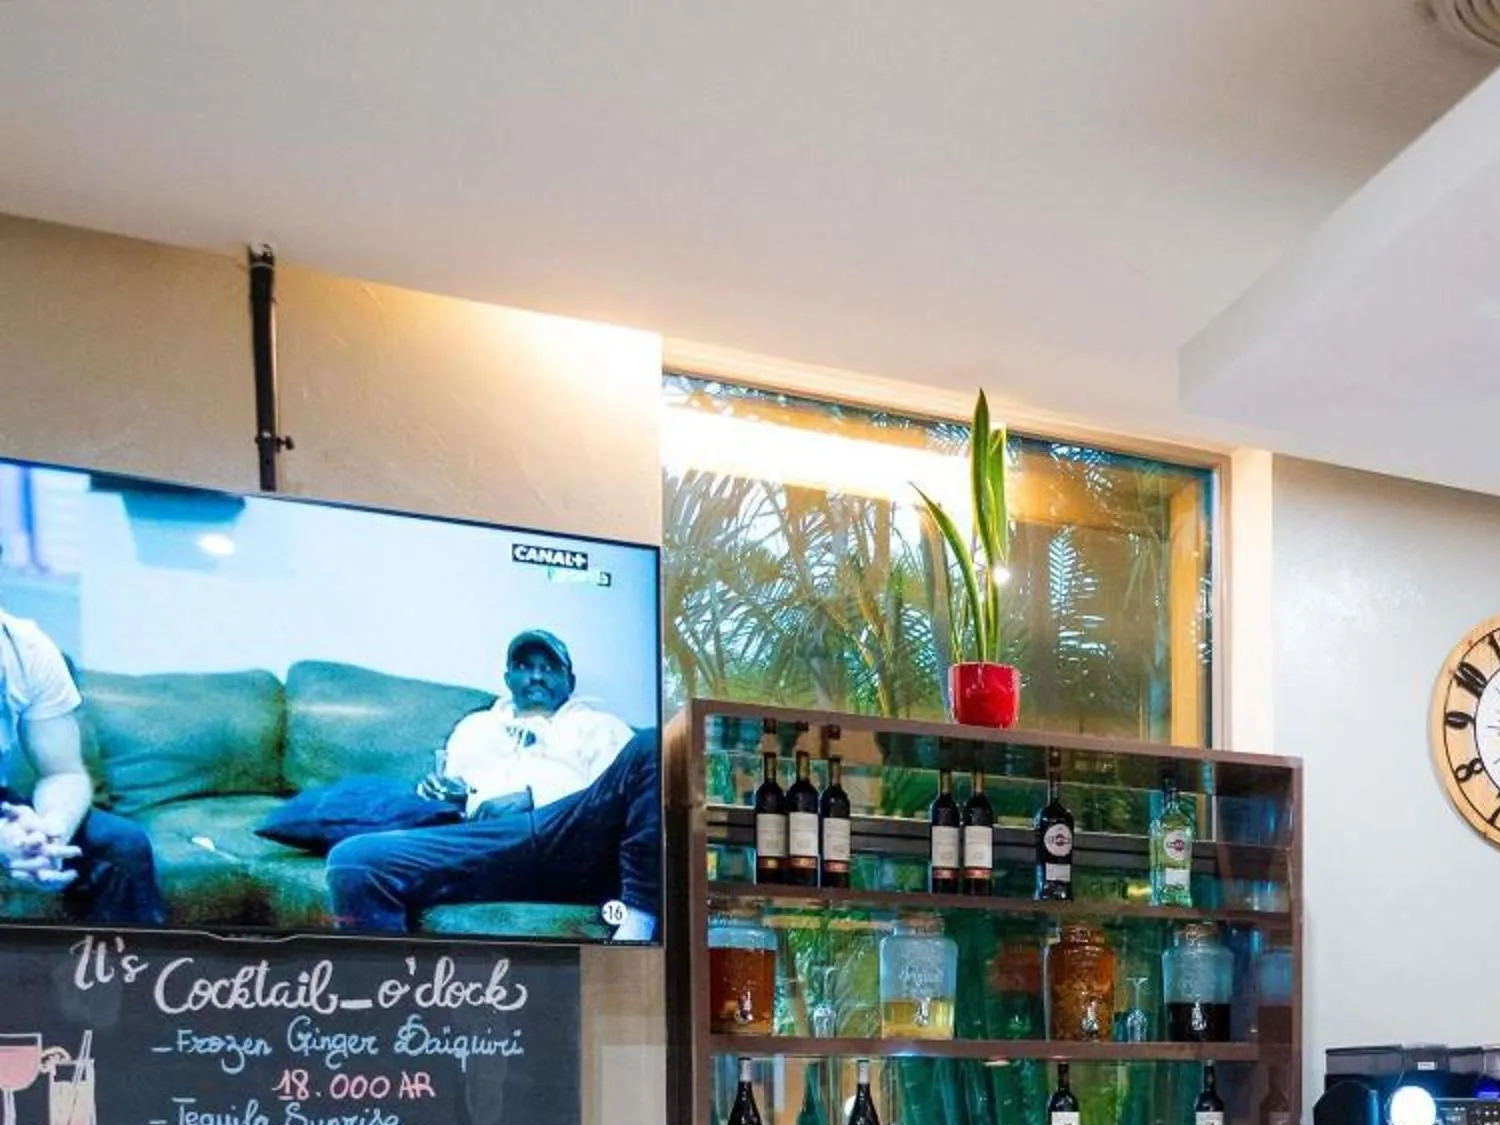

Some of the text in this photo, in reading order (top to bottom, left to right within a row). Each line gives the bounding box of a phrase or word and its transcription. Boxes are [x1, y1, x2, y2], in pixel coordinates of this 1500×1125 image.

[513, 545, 587, 568] CANAL+
[1453, 661, 1488, 700] 10
[1455, 757, 1485, 783] 8
[287, 1015, 379, 1070] Ginger
[272, 1068, 437, 1101] 18.000 AR
